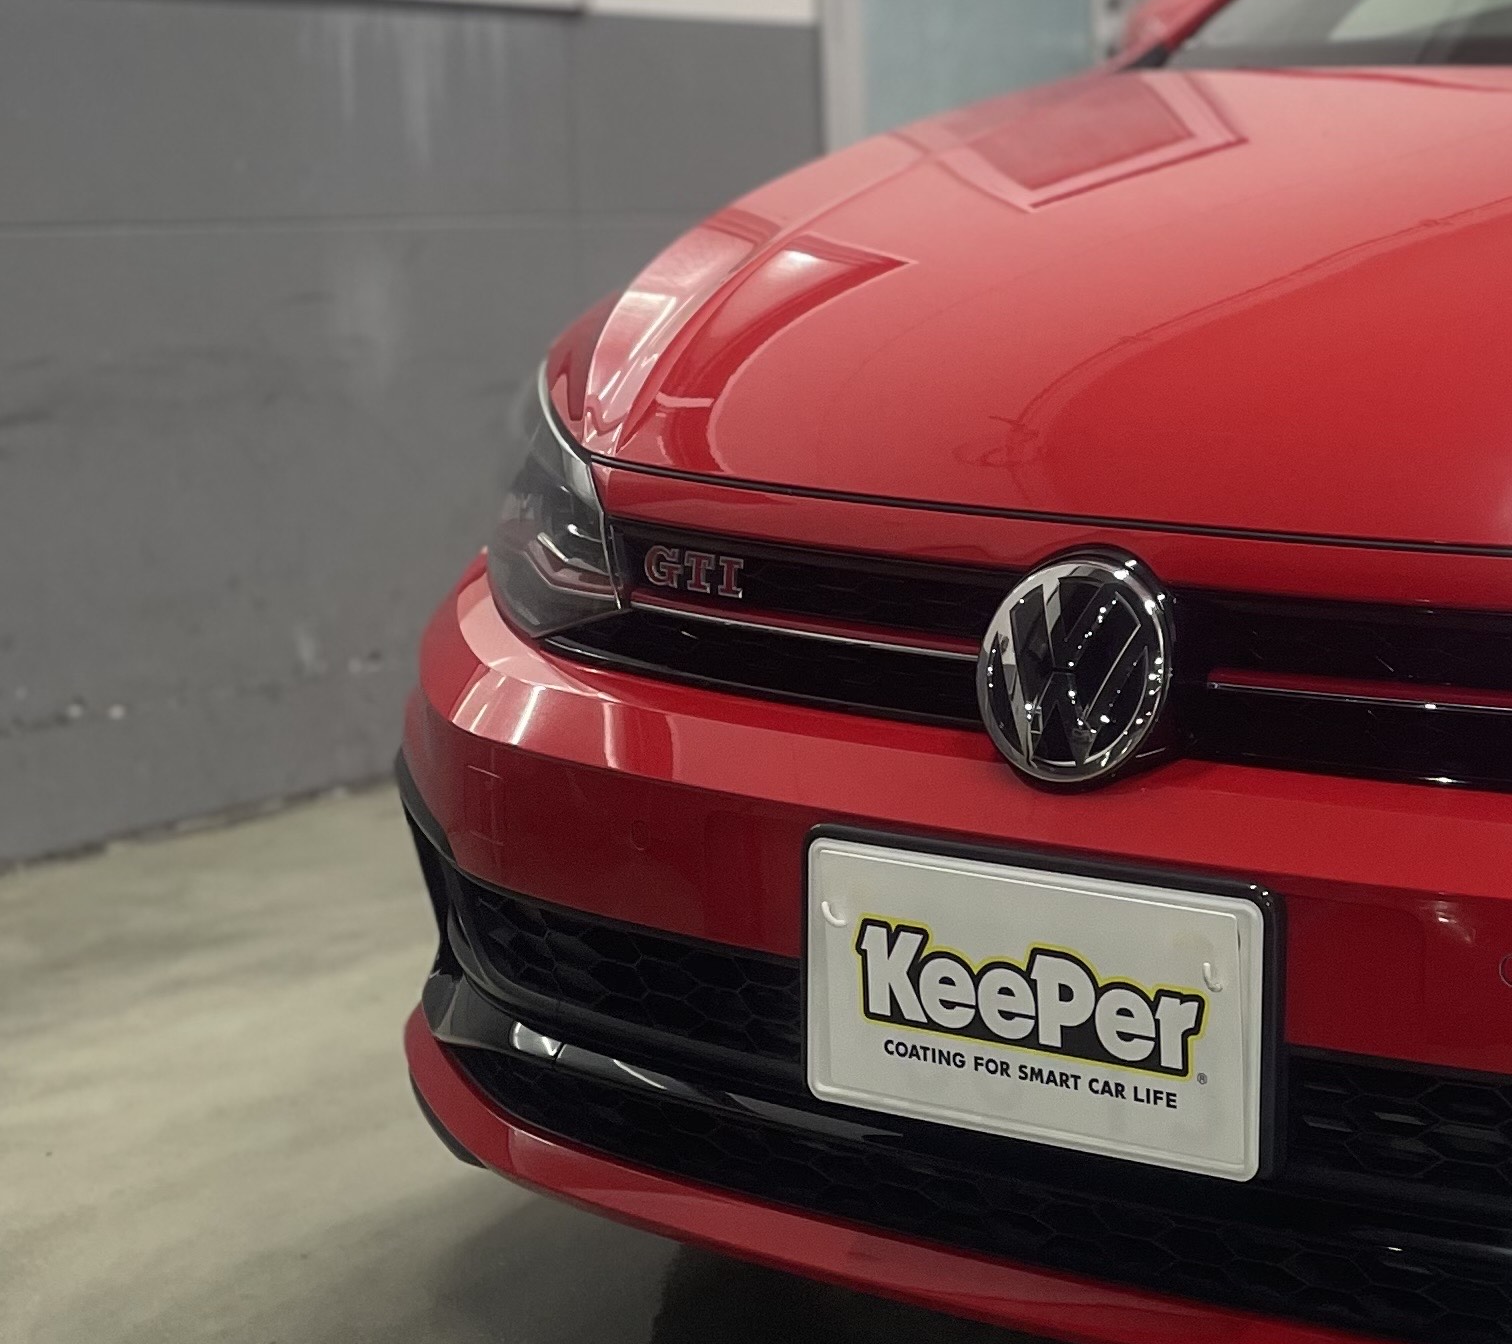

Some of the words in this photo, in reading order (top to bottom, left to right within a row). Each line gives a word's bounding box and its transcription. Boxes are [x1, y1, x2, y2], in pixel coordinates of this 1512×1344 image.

[644, 545, 744, 599] GTI
[857, 918, 1205, 1077] KeePer
[883, 1039, 967, 1069] COATING
[973, 1055, 1011, 1078] FOR
[1017, 1064, 1081, 1091] SMART
[1088, 1077, 1127, 1100] CAR
[1133, 1086, 1178, 1109] LIFE
